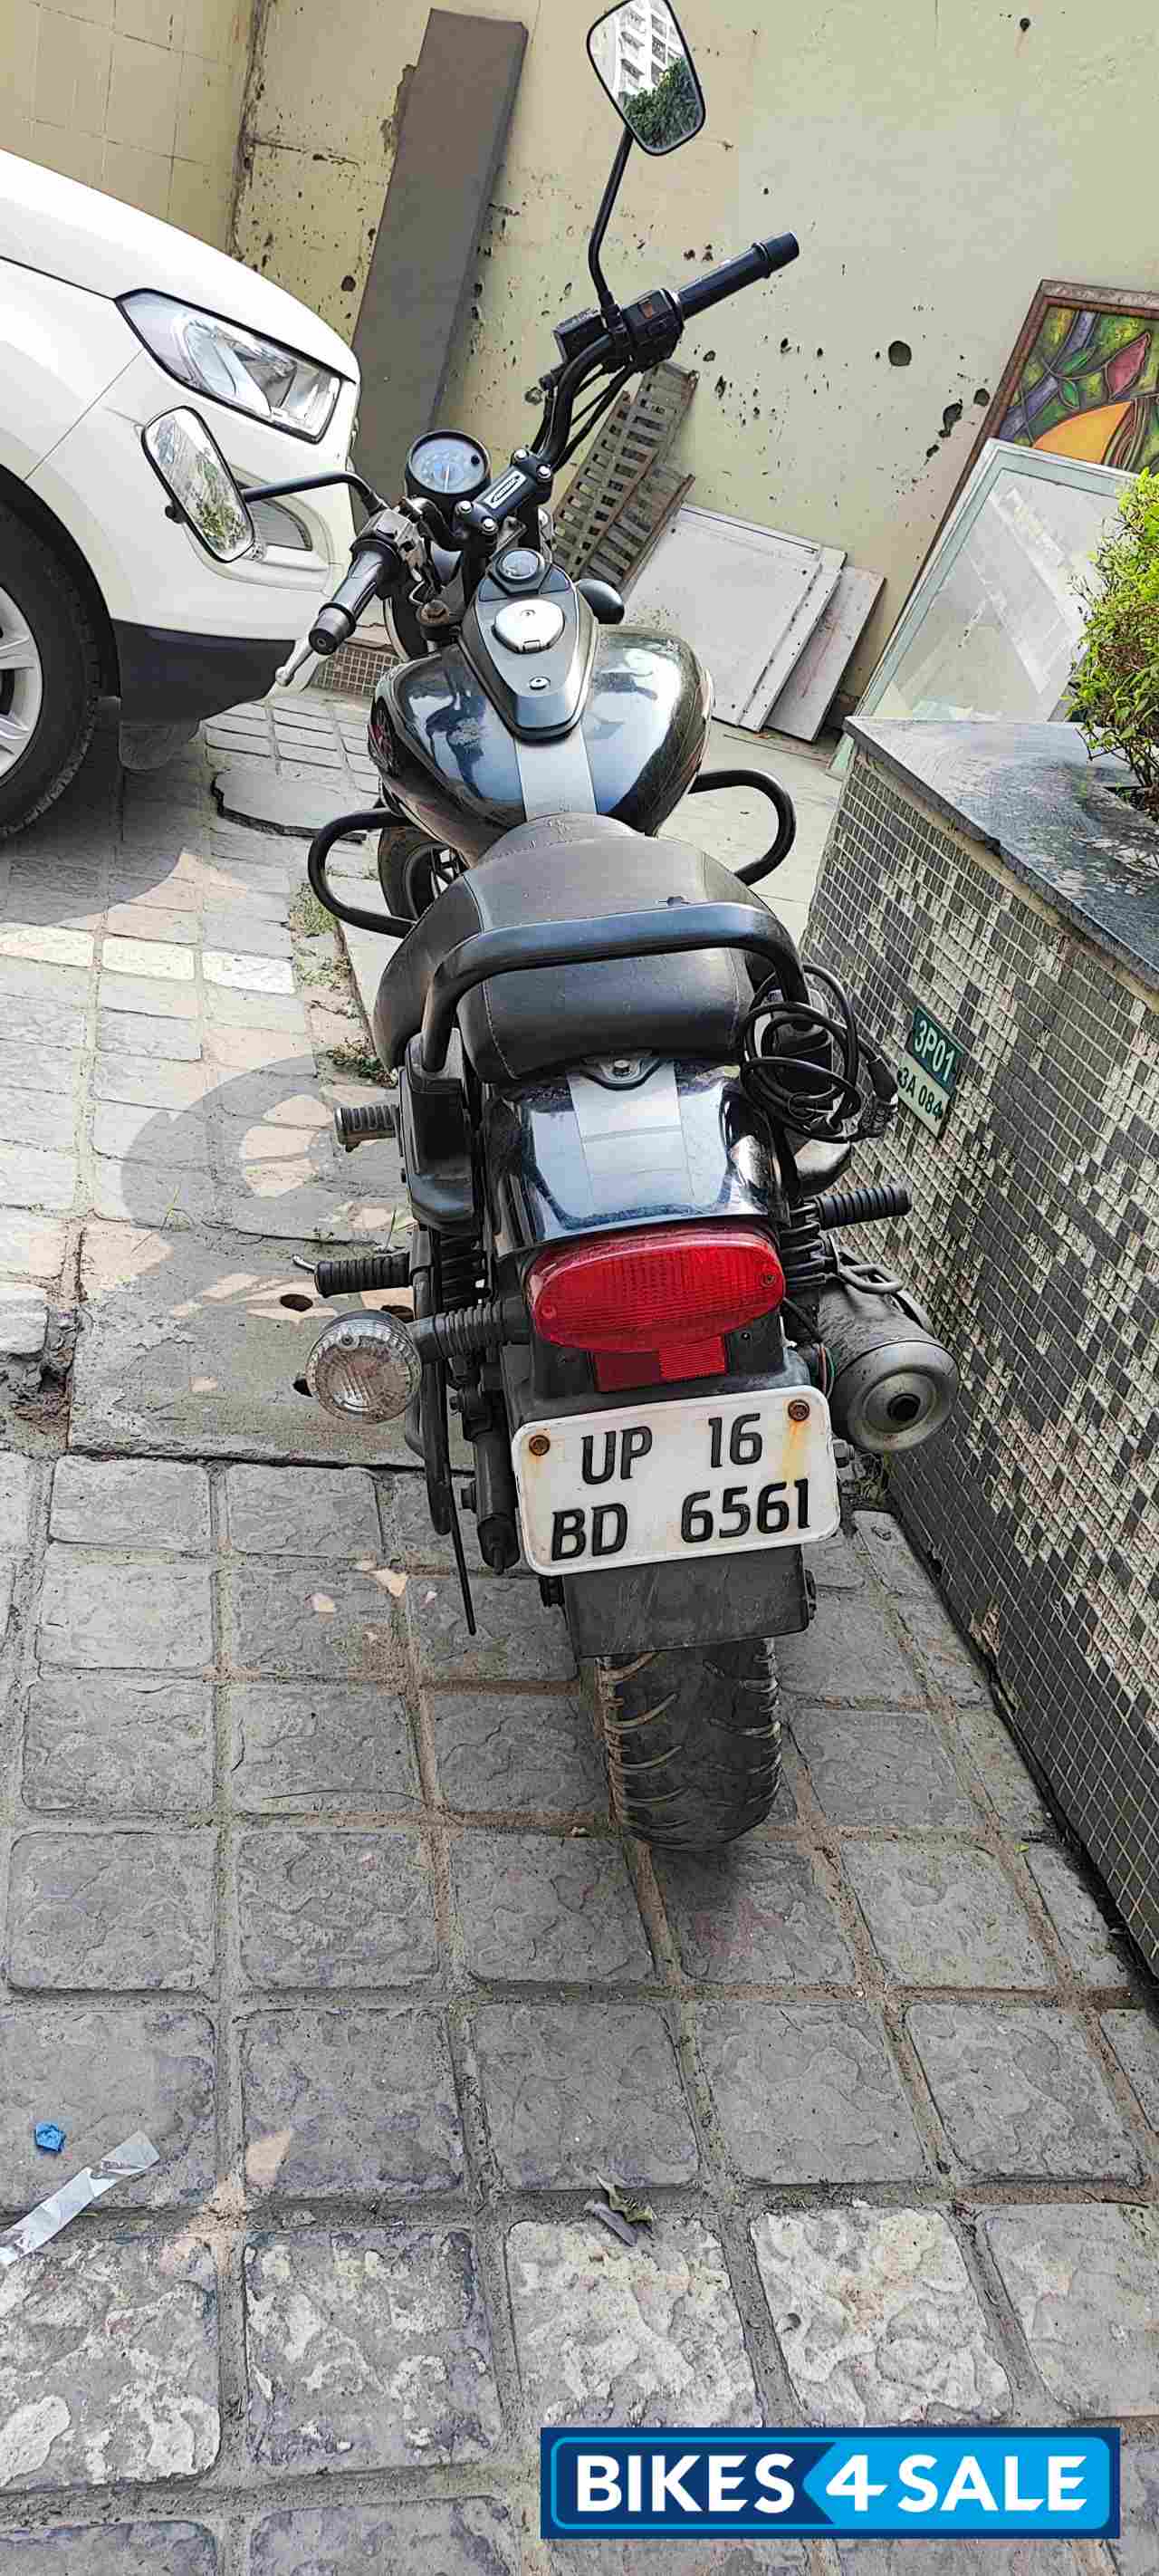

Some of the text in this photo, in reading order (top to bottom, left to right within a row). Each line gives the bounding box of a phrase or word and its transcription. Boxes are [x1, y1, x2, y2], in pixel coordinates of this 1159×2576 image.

[915, 1020, 955, 1082] 3P01
[580, 1412, 763, 1485] UP 16
[551, 1478, 811, 1562] BD 6561
